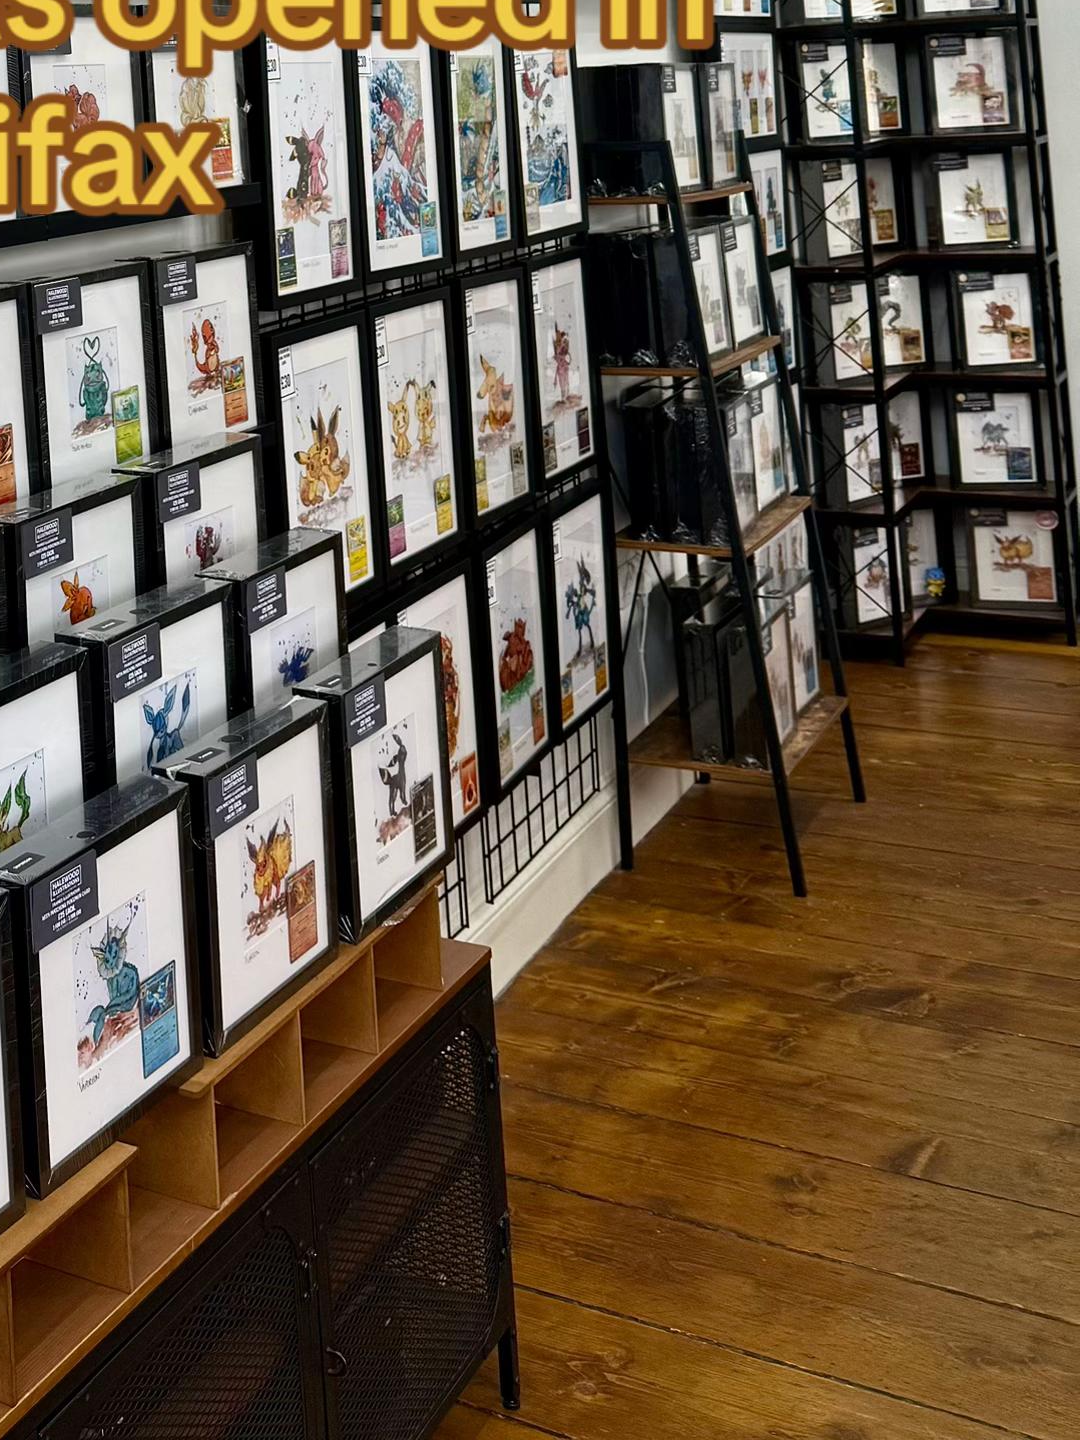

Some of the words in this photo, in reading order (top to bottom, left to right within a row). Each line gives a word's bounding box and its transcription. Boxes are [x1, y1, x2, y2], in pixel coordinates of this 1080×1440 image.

[48, 287, 67, 296] HALEWOOD
[36, 520, 58, 535] HALEWOOD
[123, 637, 145, 653] HALEWOOD
[52, 867, 79, 890] HALEWOOD
